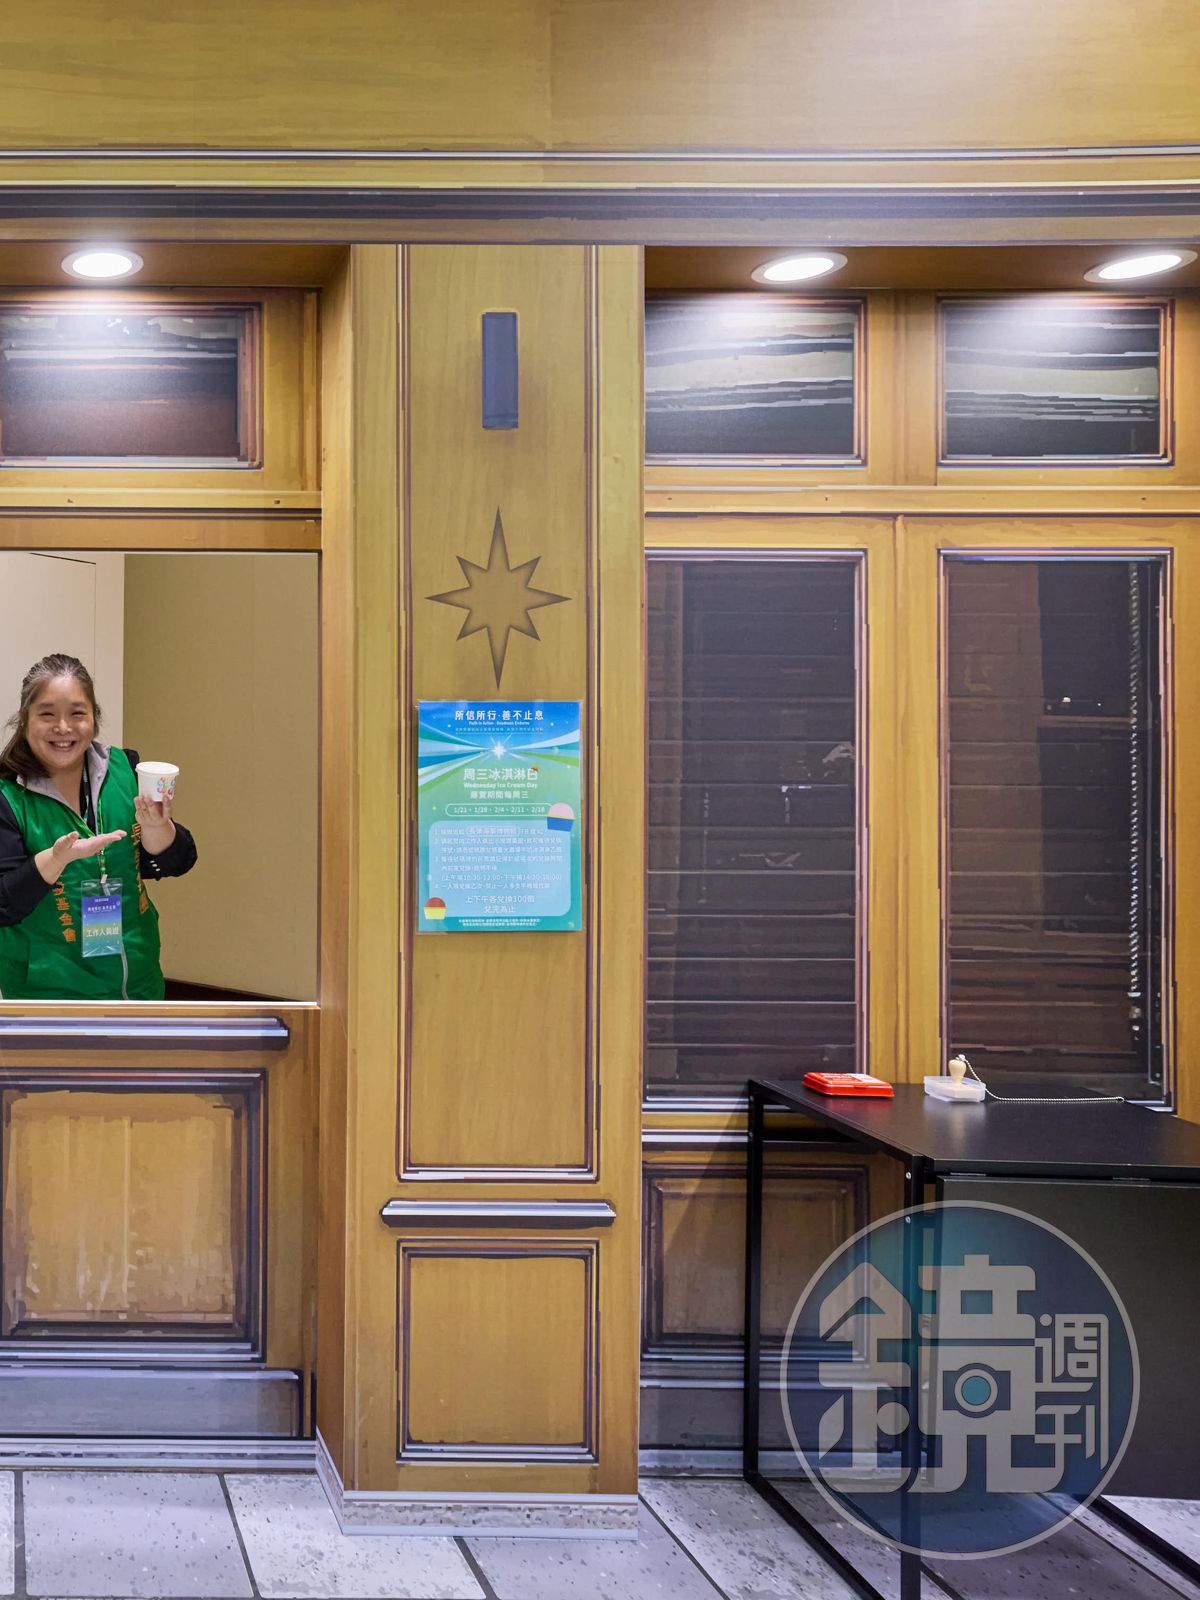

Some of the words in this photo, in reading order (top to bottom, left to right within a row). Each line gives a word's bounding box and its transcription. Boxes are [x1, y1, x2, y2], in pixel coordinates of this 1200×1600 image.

[464, 768, 538, 781] 周三冰淇淋日
